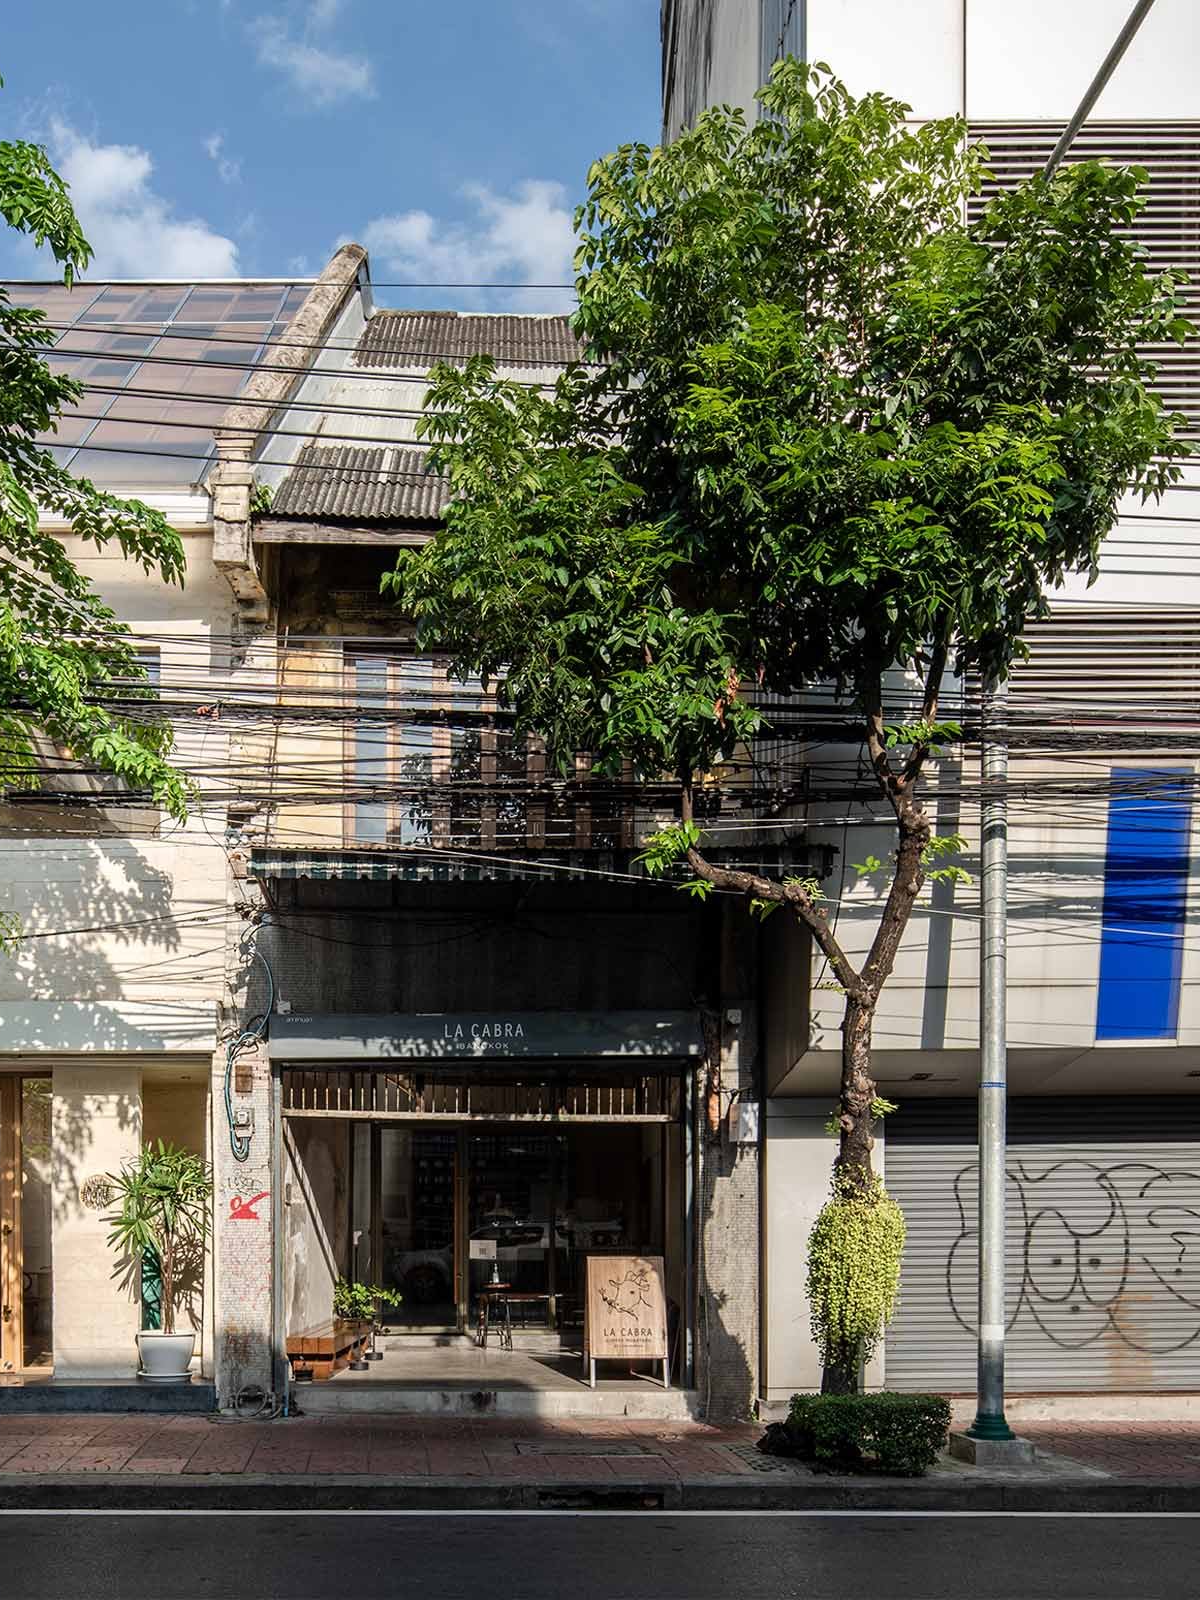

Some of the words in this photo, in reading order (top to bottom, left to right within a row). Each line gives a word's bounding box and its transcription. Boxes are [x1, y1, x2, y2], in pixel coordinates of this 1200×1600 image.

[444, 1023, 463, 1038] LA
[471, 1023, 524, 1038] CABRA
[603, 1327, 616, 1337] LA
[620, 1327, 653, 1337] CABRA
